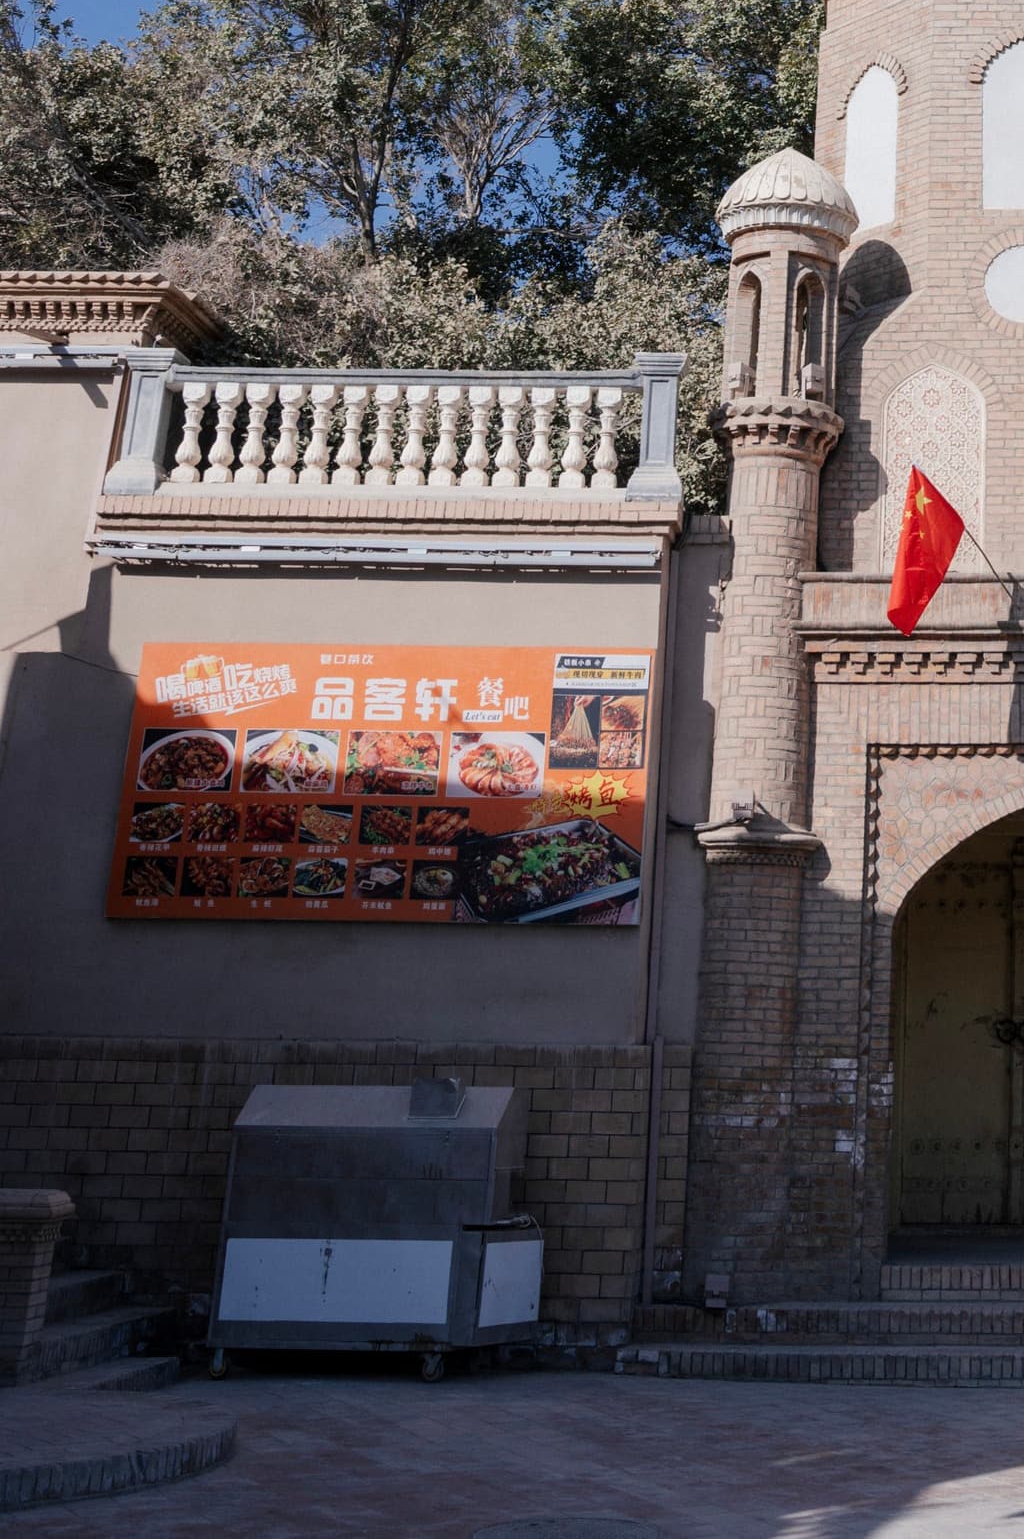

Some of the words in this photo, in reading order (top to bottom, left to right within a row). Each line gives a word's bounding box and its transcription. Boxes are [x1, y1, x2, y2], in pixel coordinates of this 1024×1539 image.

[155, 663, 291, 703] 喝啤酒吃烧烤
[172, 678, 297, 717] 生活就该这么爽
[311, 677, 458, 721] 品客轩
[477, 677, 530, 720] 餐吧
[465, 710, 486, 720] Let's
[487, 712, 500, 720] eat
